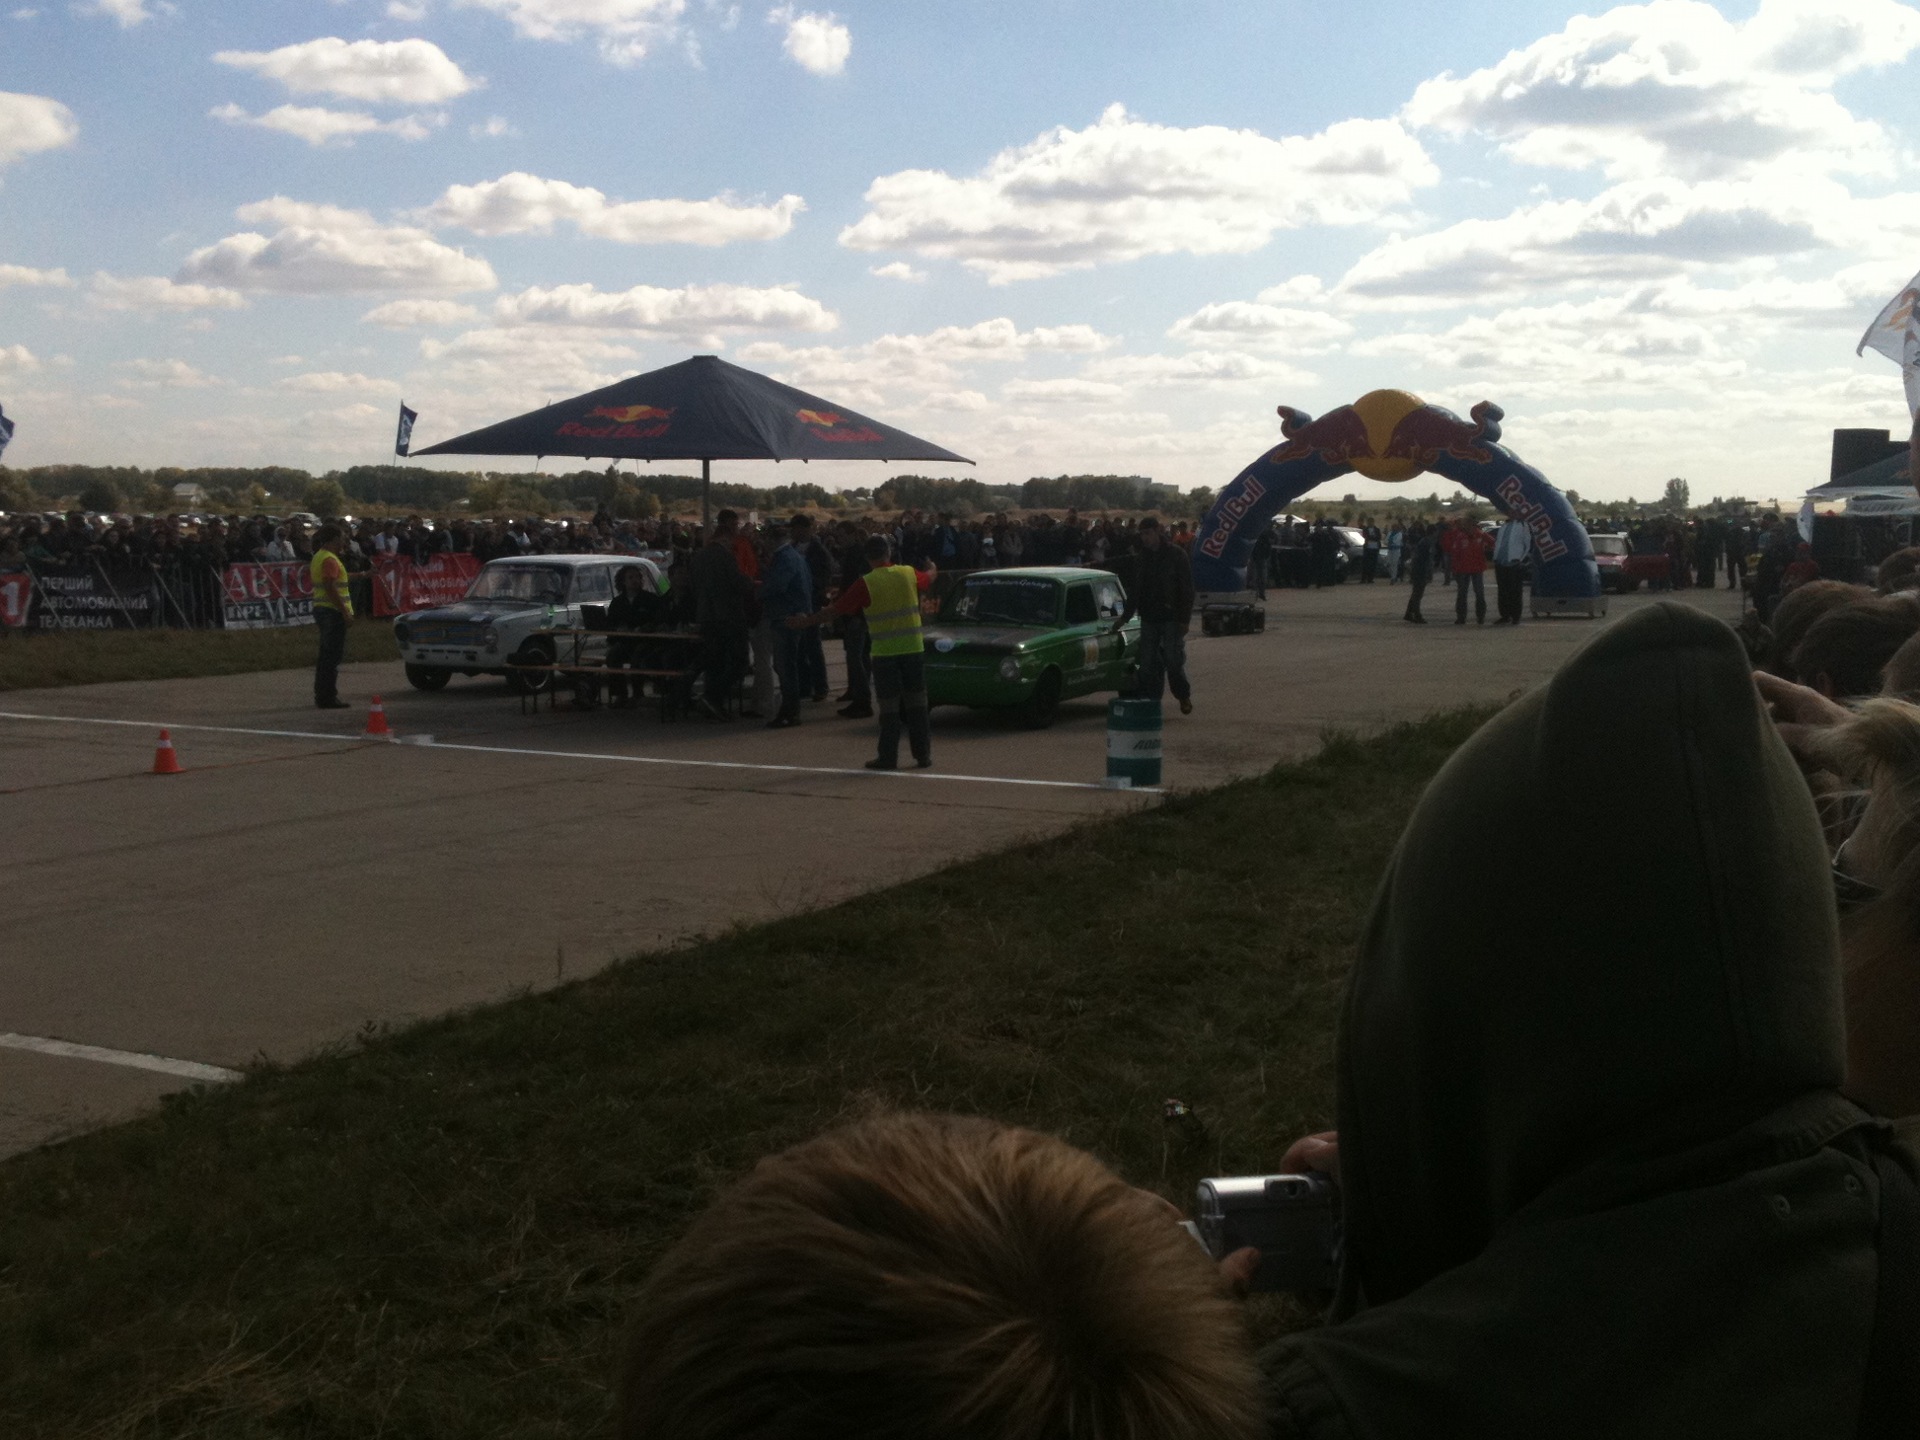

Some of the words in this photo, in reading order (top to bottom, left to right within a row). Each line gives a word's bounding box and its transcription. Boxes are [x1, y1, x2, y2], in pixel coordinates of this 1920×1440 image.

[1200, 511, 1237, 559] Red
[1226, 474, 1267, 519] Bull
[1495, 473, 1544, 525] Red
[1527, 513, 1569, 562] Bull
[41, 575, 94, 590] ПЕРШИЙ
[39, 615, 115, 629] ТЕЛЕКАНАЛ
